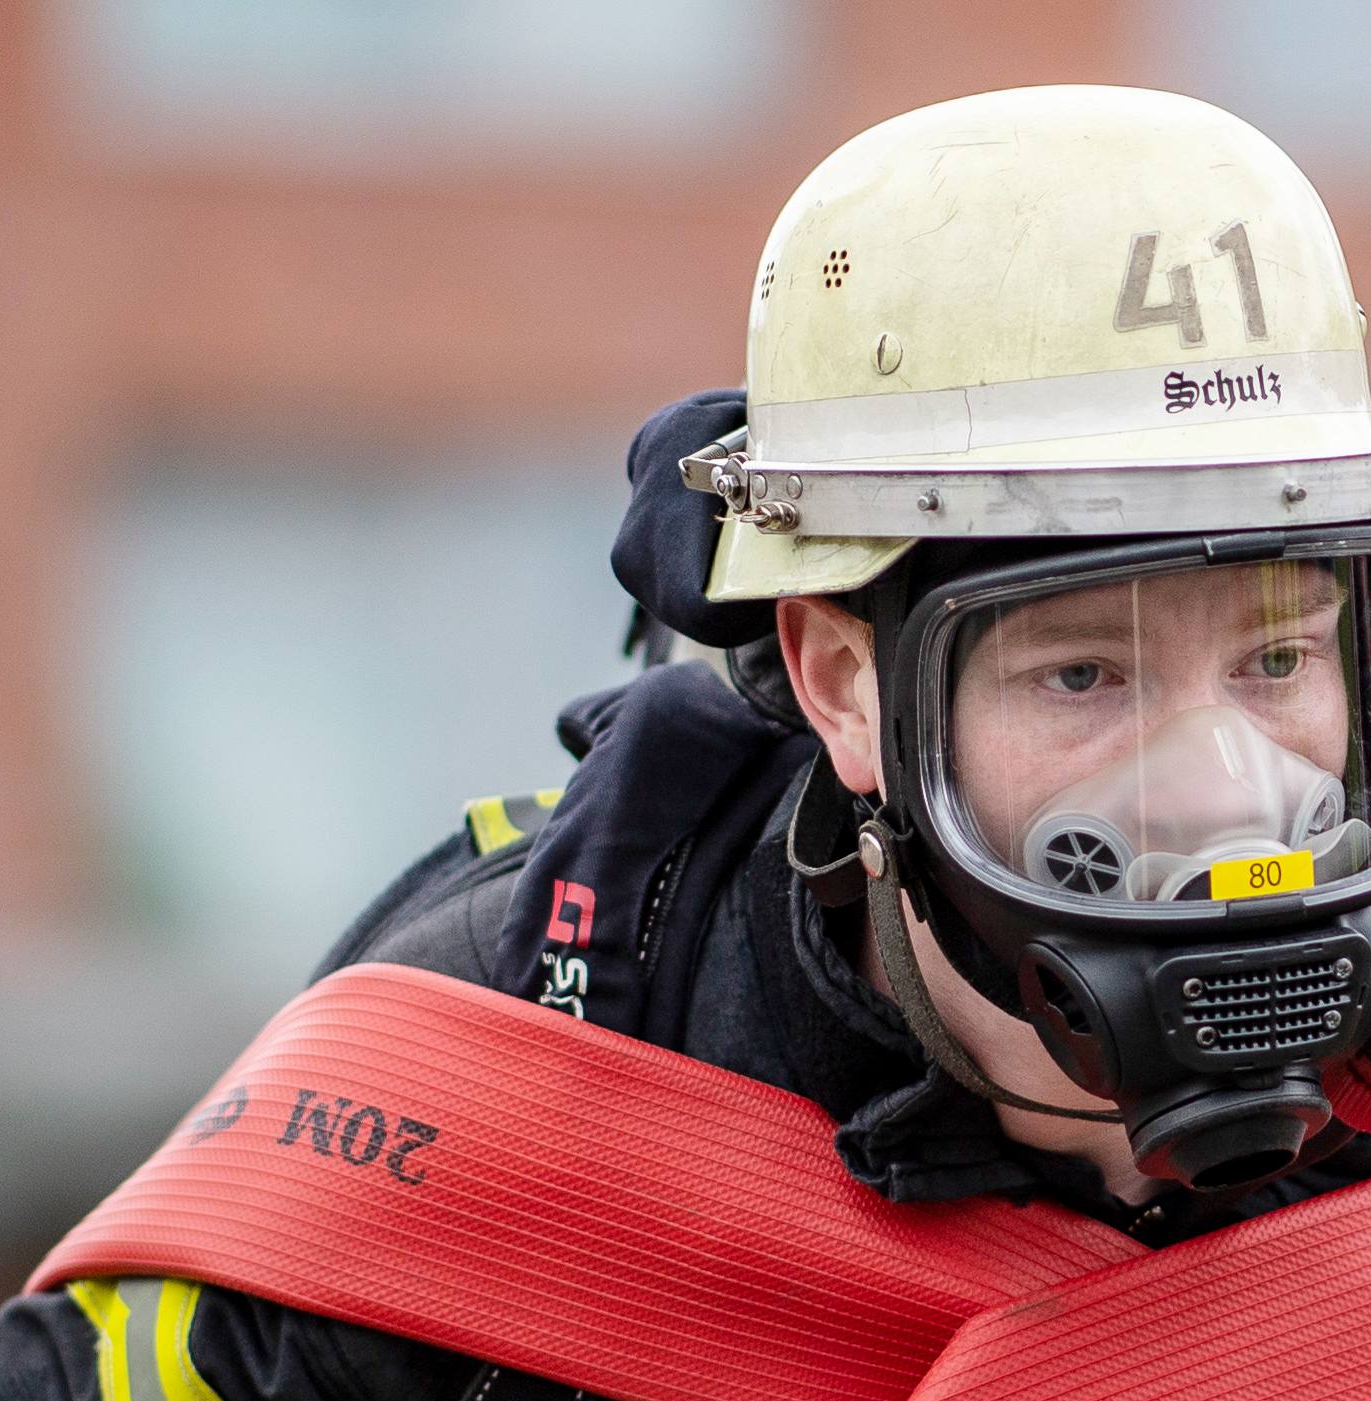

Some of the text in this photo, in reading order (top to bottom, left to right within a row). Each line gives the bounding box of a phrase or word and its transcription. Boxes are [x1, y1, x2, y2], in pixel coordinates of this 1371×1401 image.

[1114, 222, 1268, 347] 41
[1164, 364, 1282, 414] Schulz
[1249, 860, 1282, 889] 80
[277, 1088, 440, 1186] 20M
